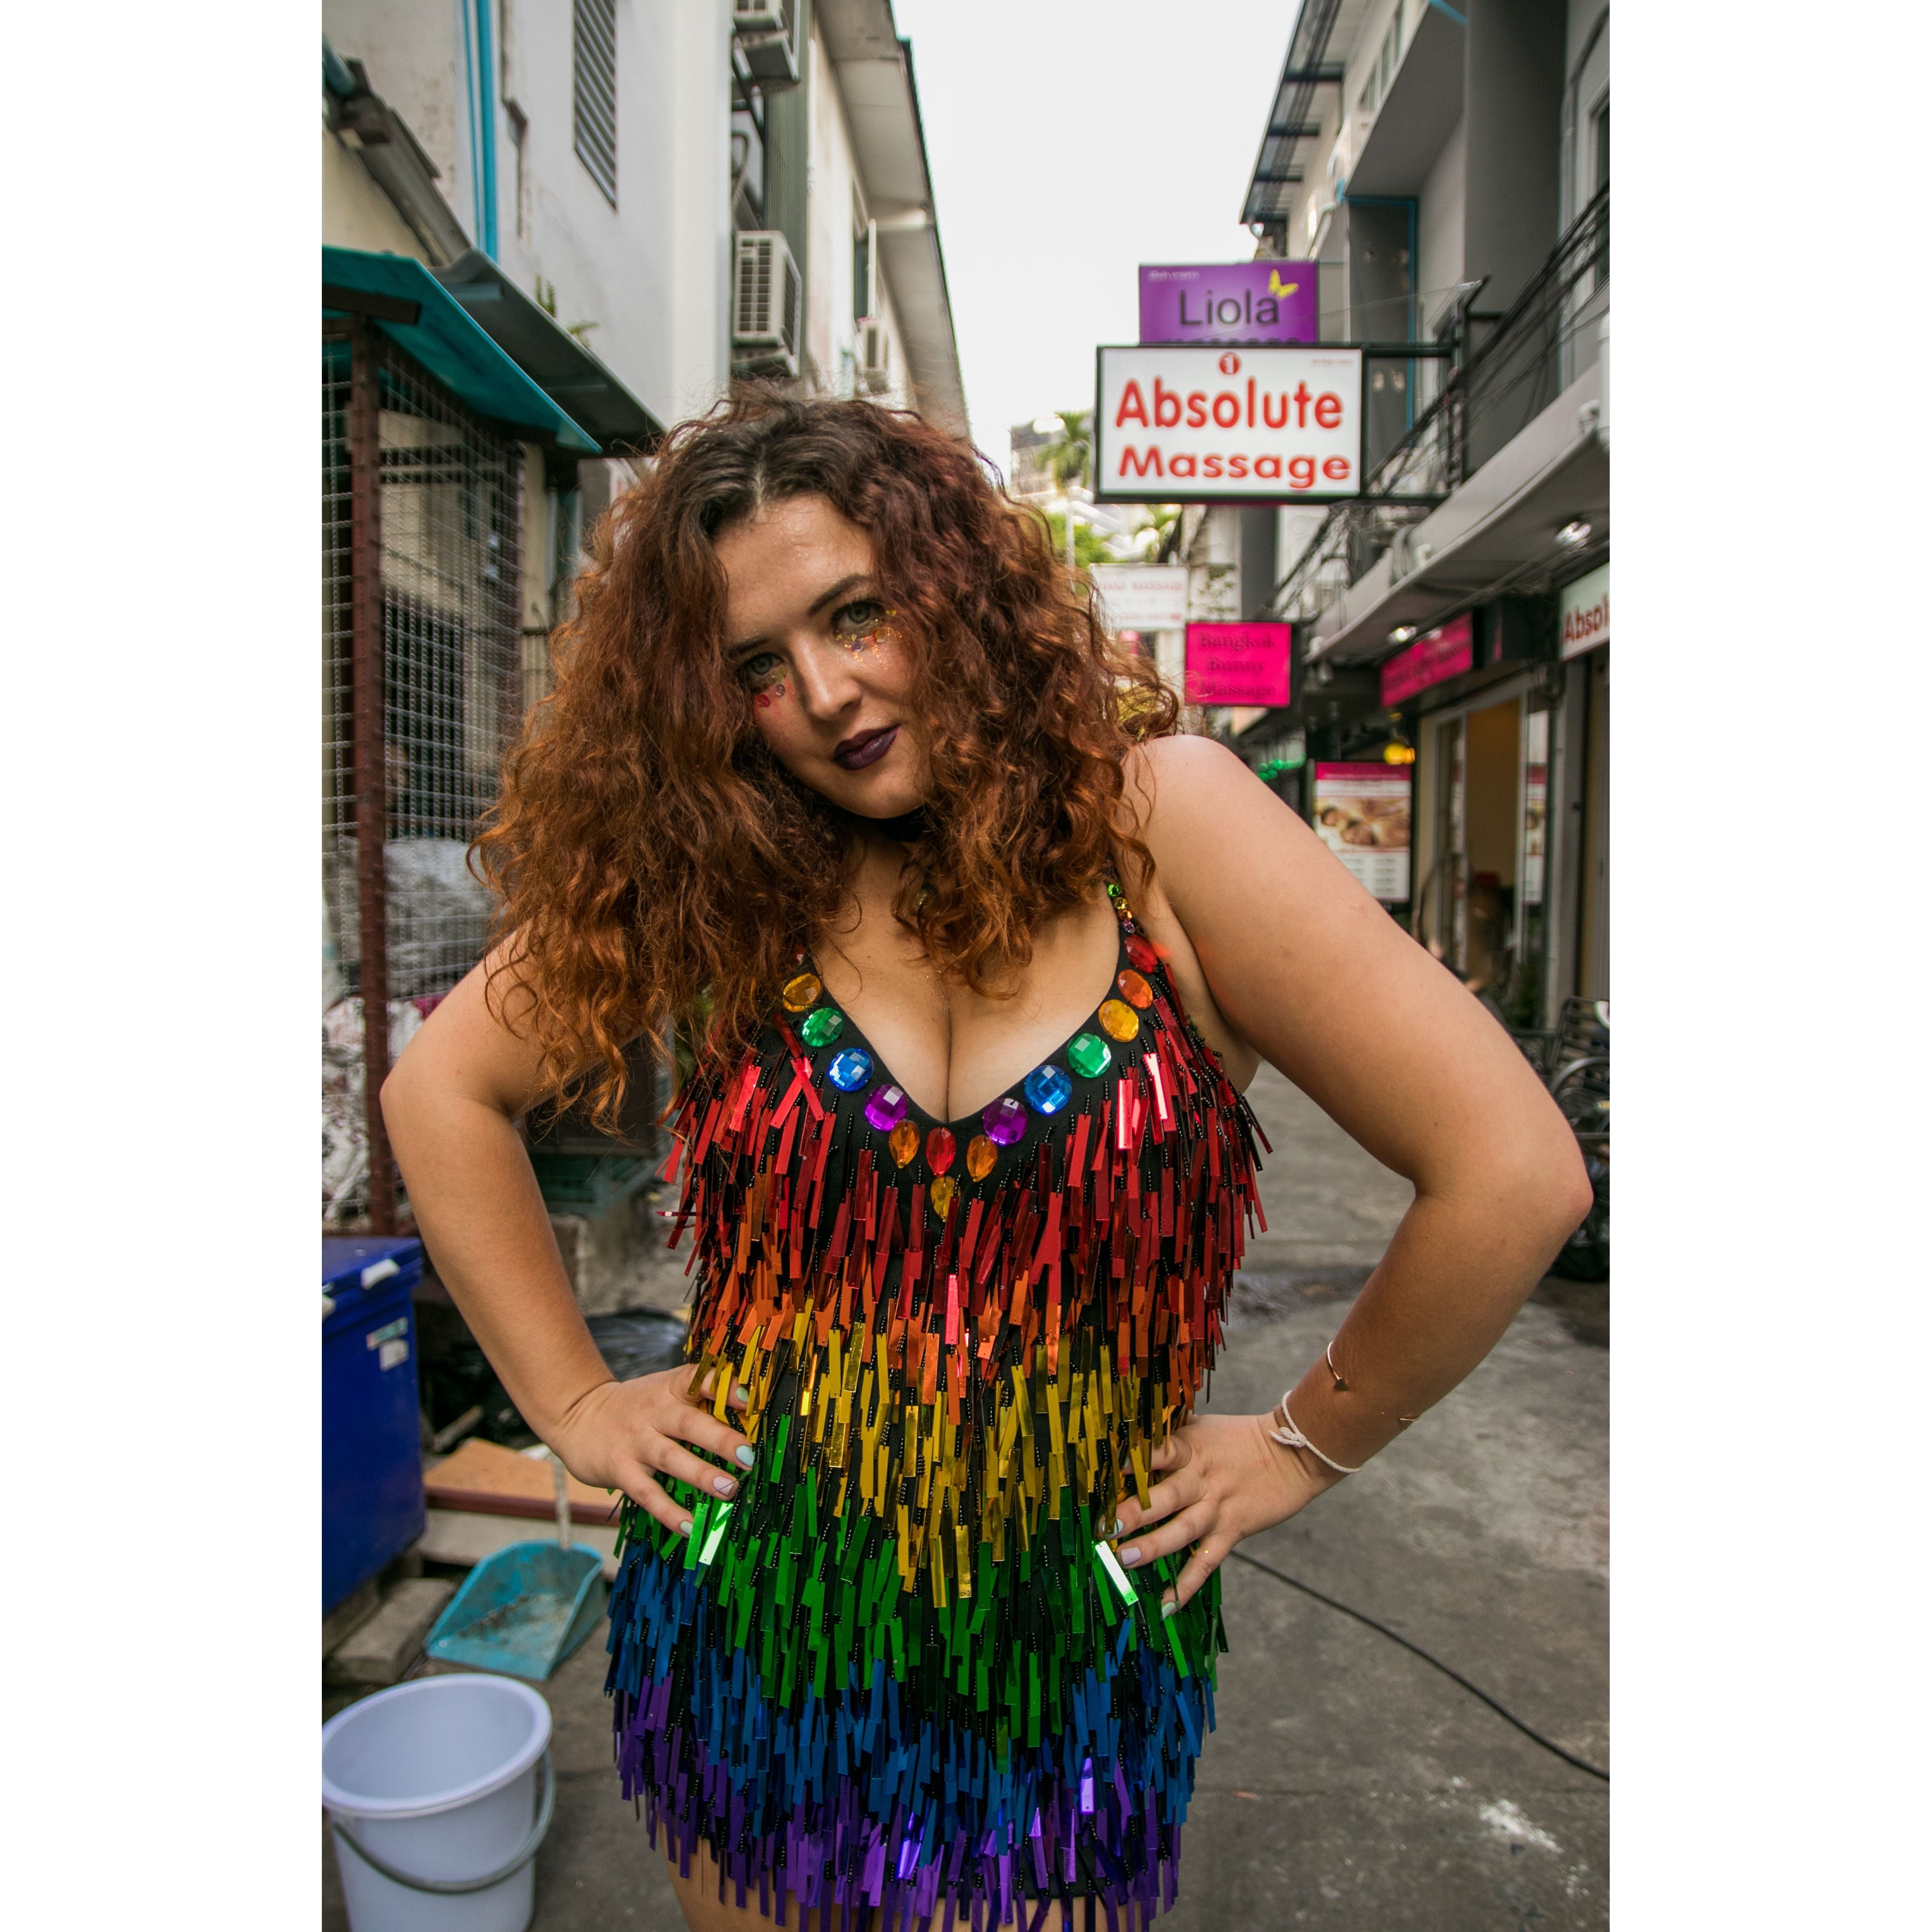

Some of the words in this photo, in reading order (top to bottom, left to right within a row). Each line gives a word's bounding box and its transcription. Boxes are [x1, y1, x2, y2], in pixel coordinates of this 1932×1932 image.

[1180, 290, 1279, 325] Liola
[1115, 376, 1343, 429] Absolute
[1118, 445, 1351, 490] Massage
[1199, 632, 1276, 651] Bangkok
[1207, 656, 1267, 676] Bunny
[1199, 680, 1275, 700] Massage
